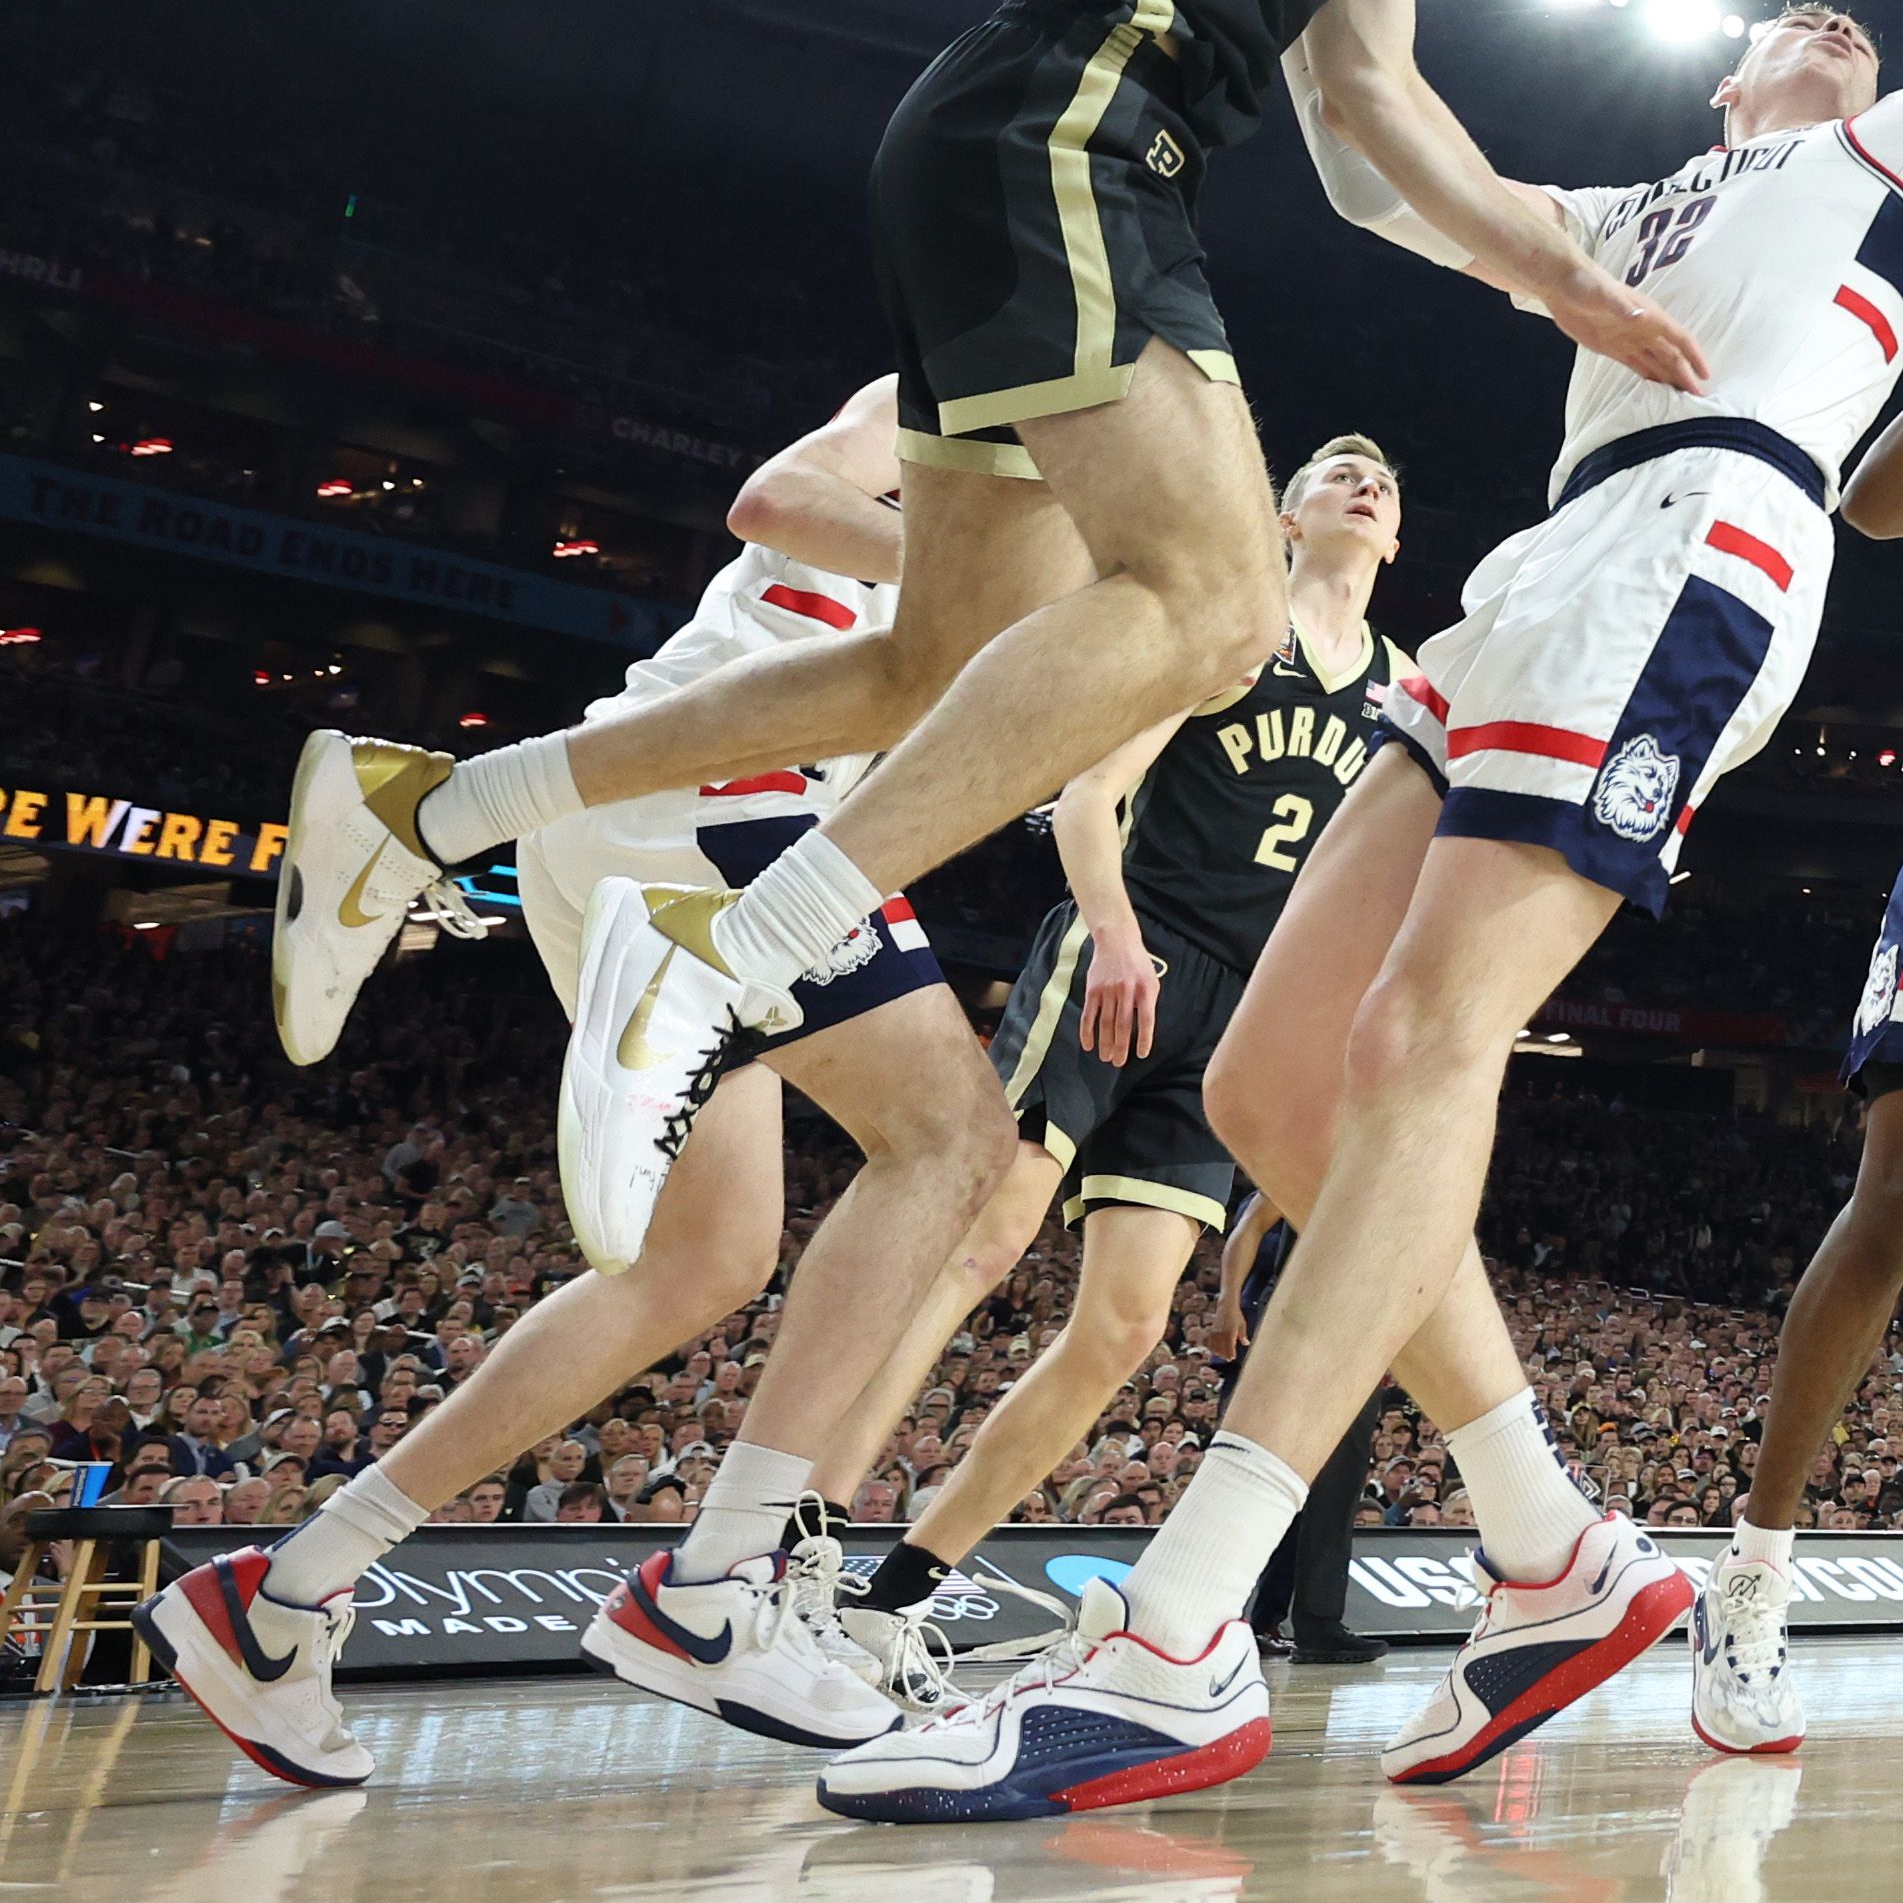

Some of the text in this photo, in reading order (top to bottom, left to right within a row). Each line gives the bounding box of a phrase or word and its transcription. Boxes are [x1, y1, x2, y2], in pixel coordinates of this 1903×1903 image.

[1604, 139, 1805, 241] CONCTICUT
[1625, 195, 1718, 288] 32
[612, 416, 743, 468] CHARLEY
[28, 472, 517, 613] THE ROAD ENDS HERE
[1216, 705, 1366, 791] PURDU
[0, 787, 48, 839] E
[65, 792, 240, 866] WERE
[1253, 793, 1314, 873] 2
[371, 1614, 578, 1637] MADE
